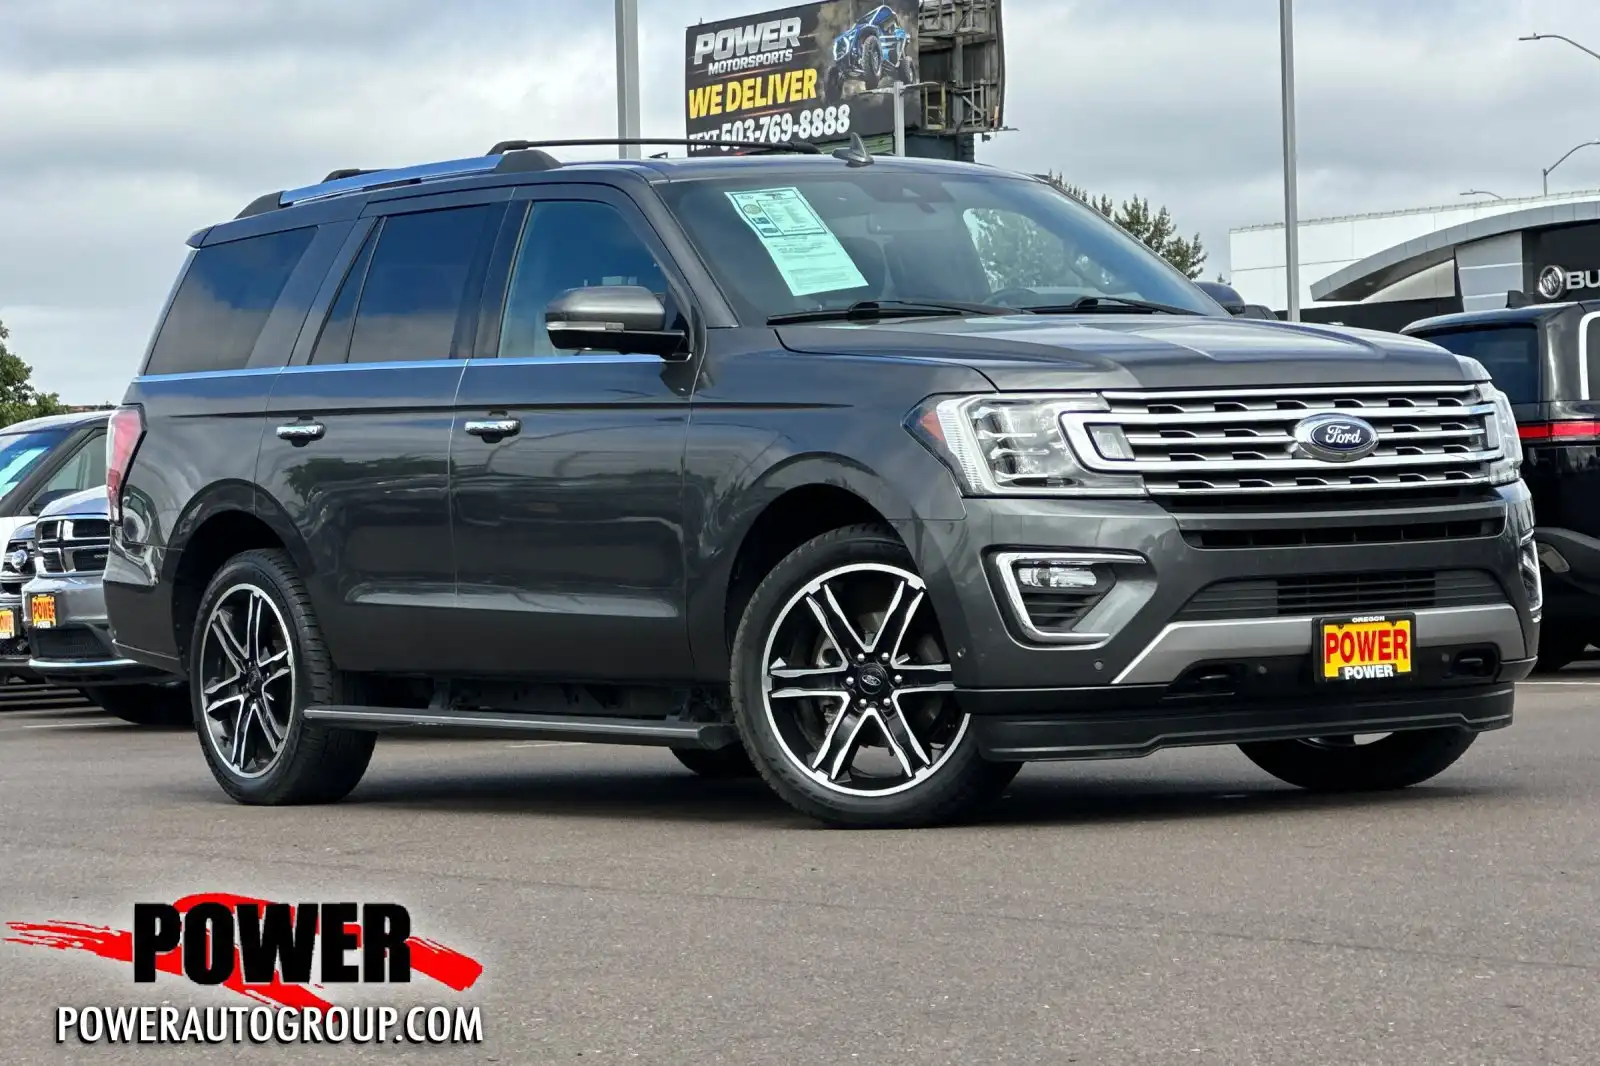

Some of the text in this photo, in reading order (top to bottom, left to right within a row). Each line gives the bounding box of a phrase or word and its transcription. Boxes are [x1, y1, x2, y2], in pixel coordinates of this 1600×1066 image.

[693, 17, 801, 65] POWER
[708, 48, 793, 76] MOTORSPORTS
[688, 68, 817, 119] WE DELIVER
[720, 104, 850, 151] 503-769-8888
[1325, 425, 1362, 443] Ford
[1326, 629, 1408, 664] POWER
[1344, 664, 1394, 680] POWER
